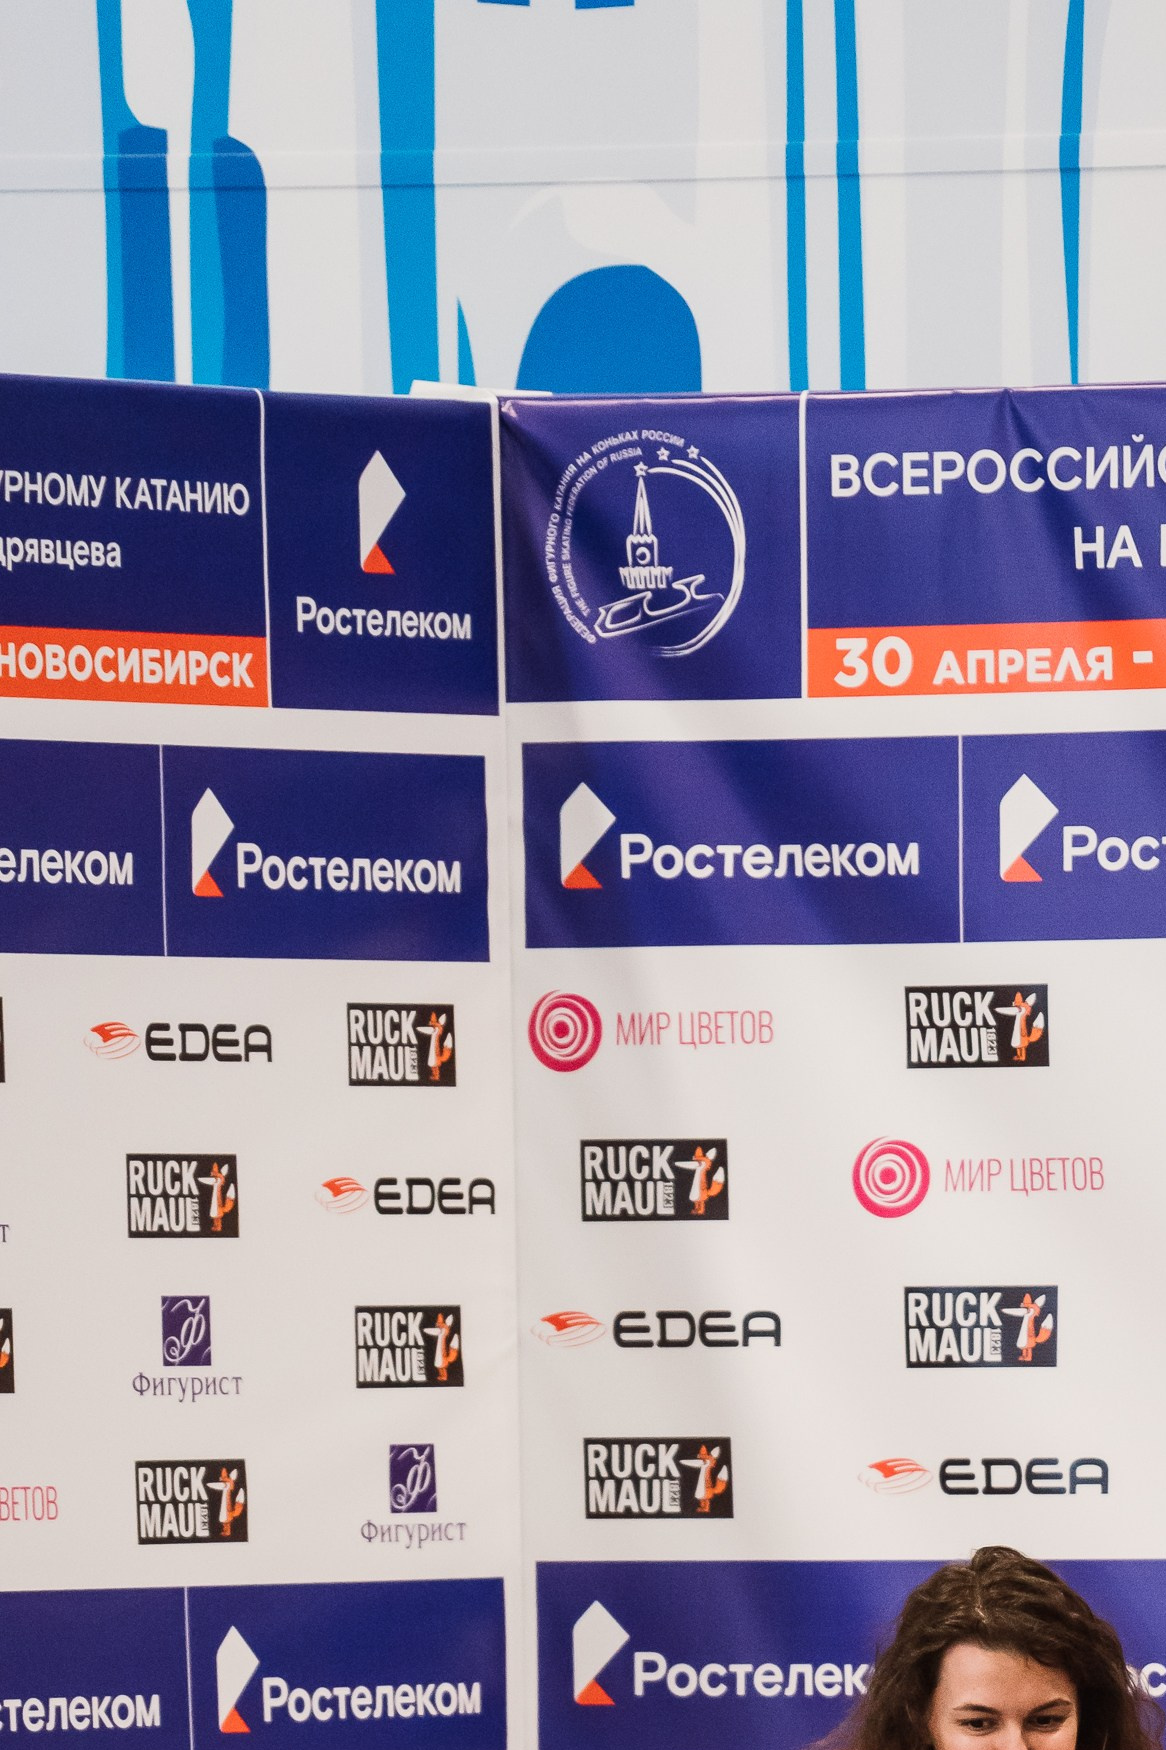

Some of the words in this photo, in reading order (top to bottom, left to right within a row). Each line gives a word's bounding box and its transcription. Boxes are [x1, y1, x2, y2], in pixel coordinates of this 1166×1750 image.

[597, 456, 609, 470] OF
[610, 447, 642, 464] RUSSIA
[115, 476, 250, 516] КАТАНИЮ
[545, 513, 560, 582] ФИГУРНОГО
[554, 464, 577, 510] КАТАНИЯ
[576, 452, 592, 467] НА
[592, 430, 638, 454] КОНЬКАХ
[642, 430, 685, 447] РОССИИ
[1073, 524, 1142, 570] НА
[297, 597, 472, 641] Ростелеком
[0, 642, 254, 688] НОВОСИБИРСК
[834, 636, 913, 687] 30
[933, 646, 1113, 685] АПРЕЛЯ
[237, 842, 461, 893] Ростелеком
[620, 832, 919, 876] Ростелеком
[350, 1008, 418, 1044] RUCK
[909, 991, 996, 1027] RUCK
[145, 1022, 272, 1062] EDEA
[616, 1013, 670, 1047] МИР
[678, 1010, 773, 1050] ЦВЕТОВ
[910, 1027, 998, 1062] MAUL
[350, 1046, 418, 1080] MAUL
[128, 1159, 199, 1196] RUCK
[584, 1145, 674, 1181] RUCK
[944, 1159, 1001, 1192] МИР
[1009, 1157, 1104, 1196] ЦВЕТОВ
[374, 1177, 496, 1215] EDEA
[585, 1181, 674, 1216] MAUL
[130, 1197, 199, 1233] MAUL
[356, 1311, 424, 1347] RUCK
[613, 1310, 781, 1348] EDEA
[908, 1292, 1002, 1329] RUCK
[909, 1327, 1002, 1363] MAUL
[357, 1348, 425, 1383] MAUL
[132, 1371, 244, 1403] Фигурист
[588, 1444, 680, 1480] RUCK
[939, 1458, 1108, 1496] EDEA
[138, 1466, 208, 1502] RUCK
[589, 1480, 681, 1514] MAUL
[139, 1503, 209, 1540] MAUL
[360, 1518, 467, 1550] Фигурист
[262, 1676, 481, 1723] Ростелеком
